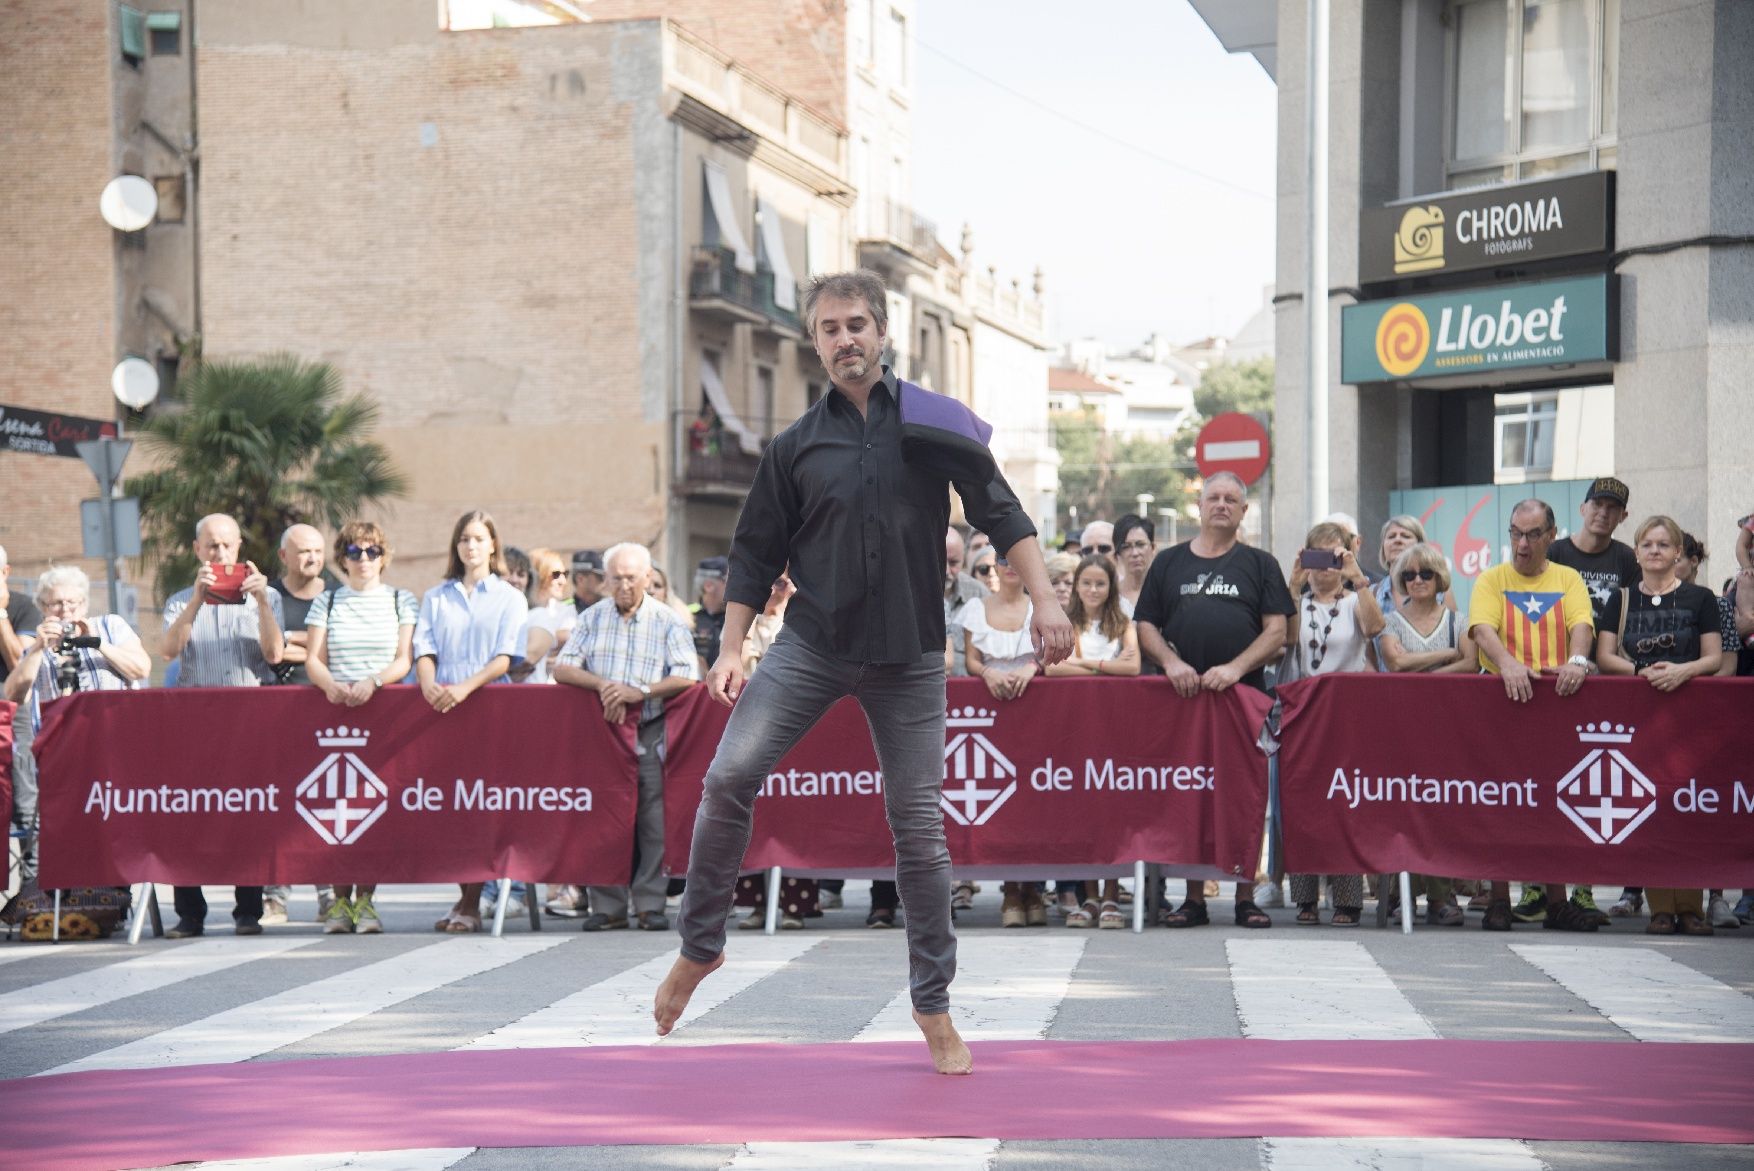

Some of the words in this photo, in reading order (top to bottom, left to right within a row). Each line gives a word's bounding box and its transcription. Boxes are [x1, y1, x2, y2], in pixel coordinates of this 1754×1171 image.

[1456, 196, 1563, 244] CHROMA
[1436, 295, 1567, 352] Llobet
[1487, 352, 1499, 363] EN
[1462, 543, 1491, 574] et
[1580, 570, 1619, 582] DIVISION
[1030, 758, 1073, 791] de
[1327, 768, 1538, 809] Ajuntament
[1673, 778, 1719, 813] de
[85, 781, 279, 820] Ajuntament
[401, 778, 443, 811] de
[454, 779, 592, 811] Manresa
